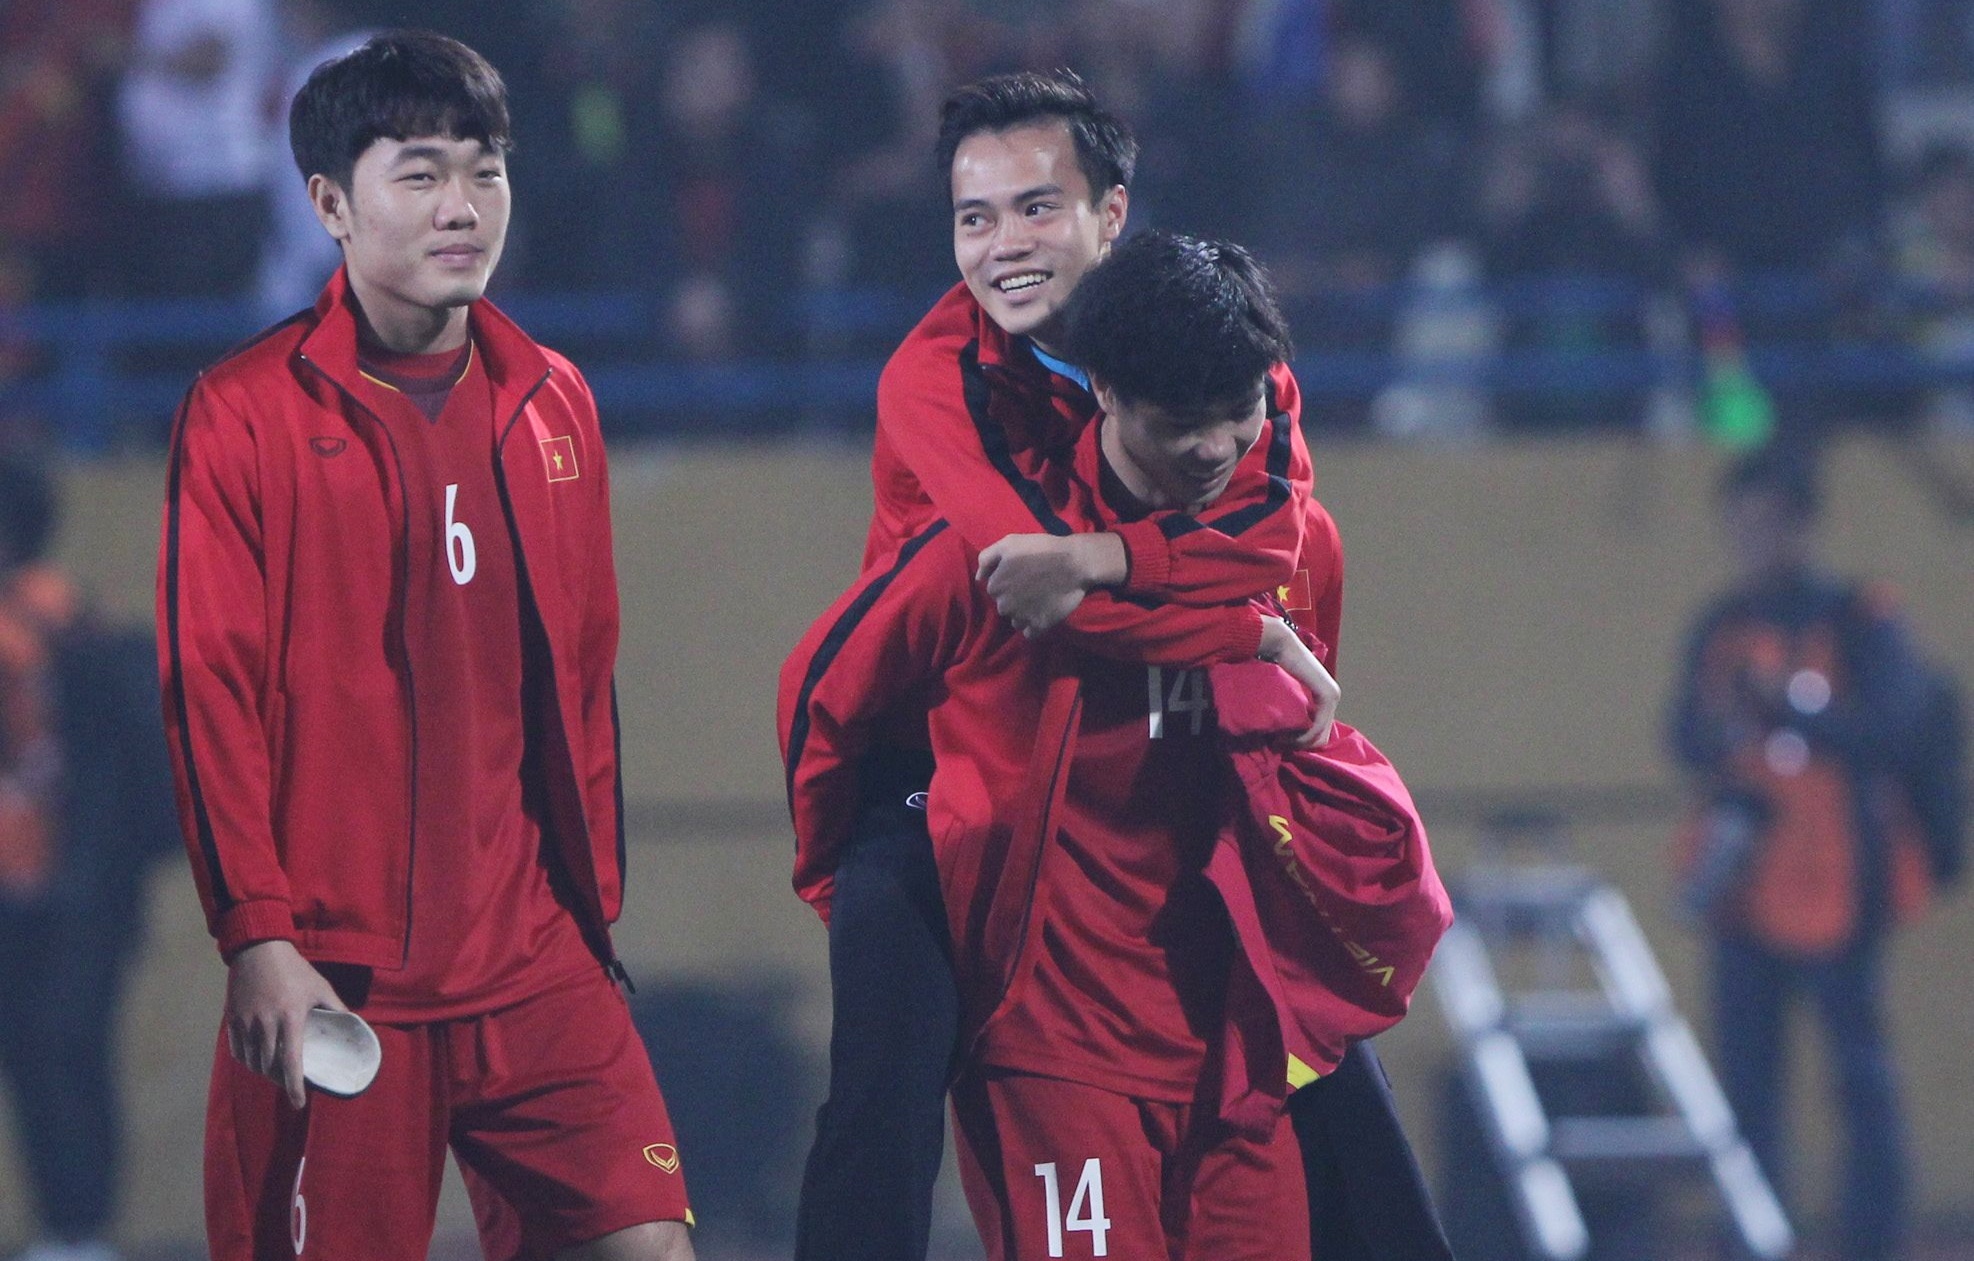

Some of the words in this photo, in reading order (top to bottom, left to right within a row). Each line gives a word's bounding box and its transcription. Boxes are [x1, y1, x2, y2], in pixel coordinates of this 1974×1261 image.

[445, 483, 476, 585] 6
[1147, 665, 1209, 739] 14
[290, 1156, 306, 1255] 6
[1034, 1157, 1111, 1257] 14
